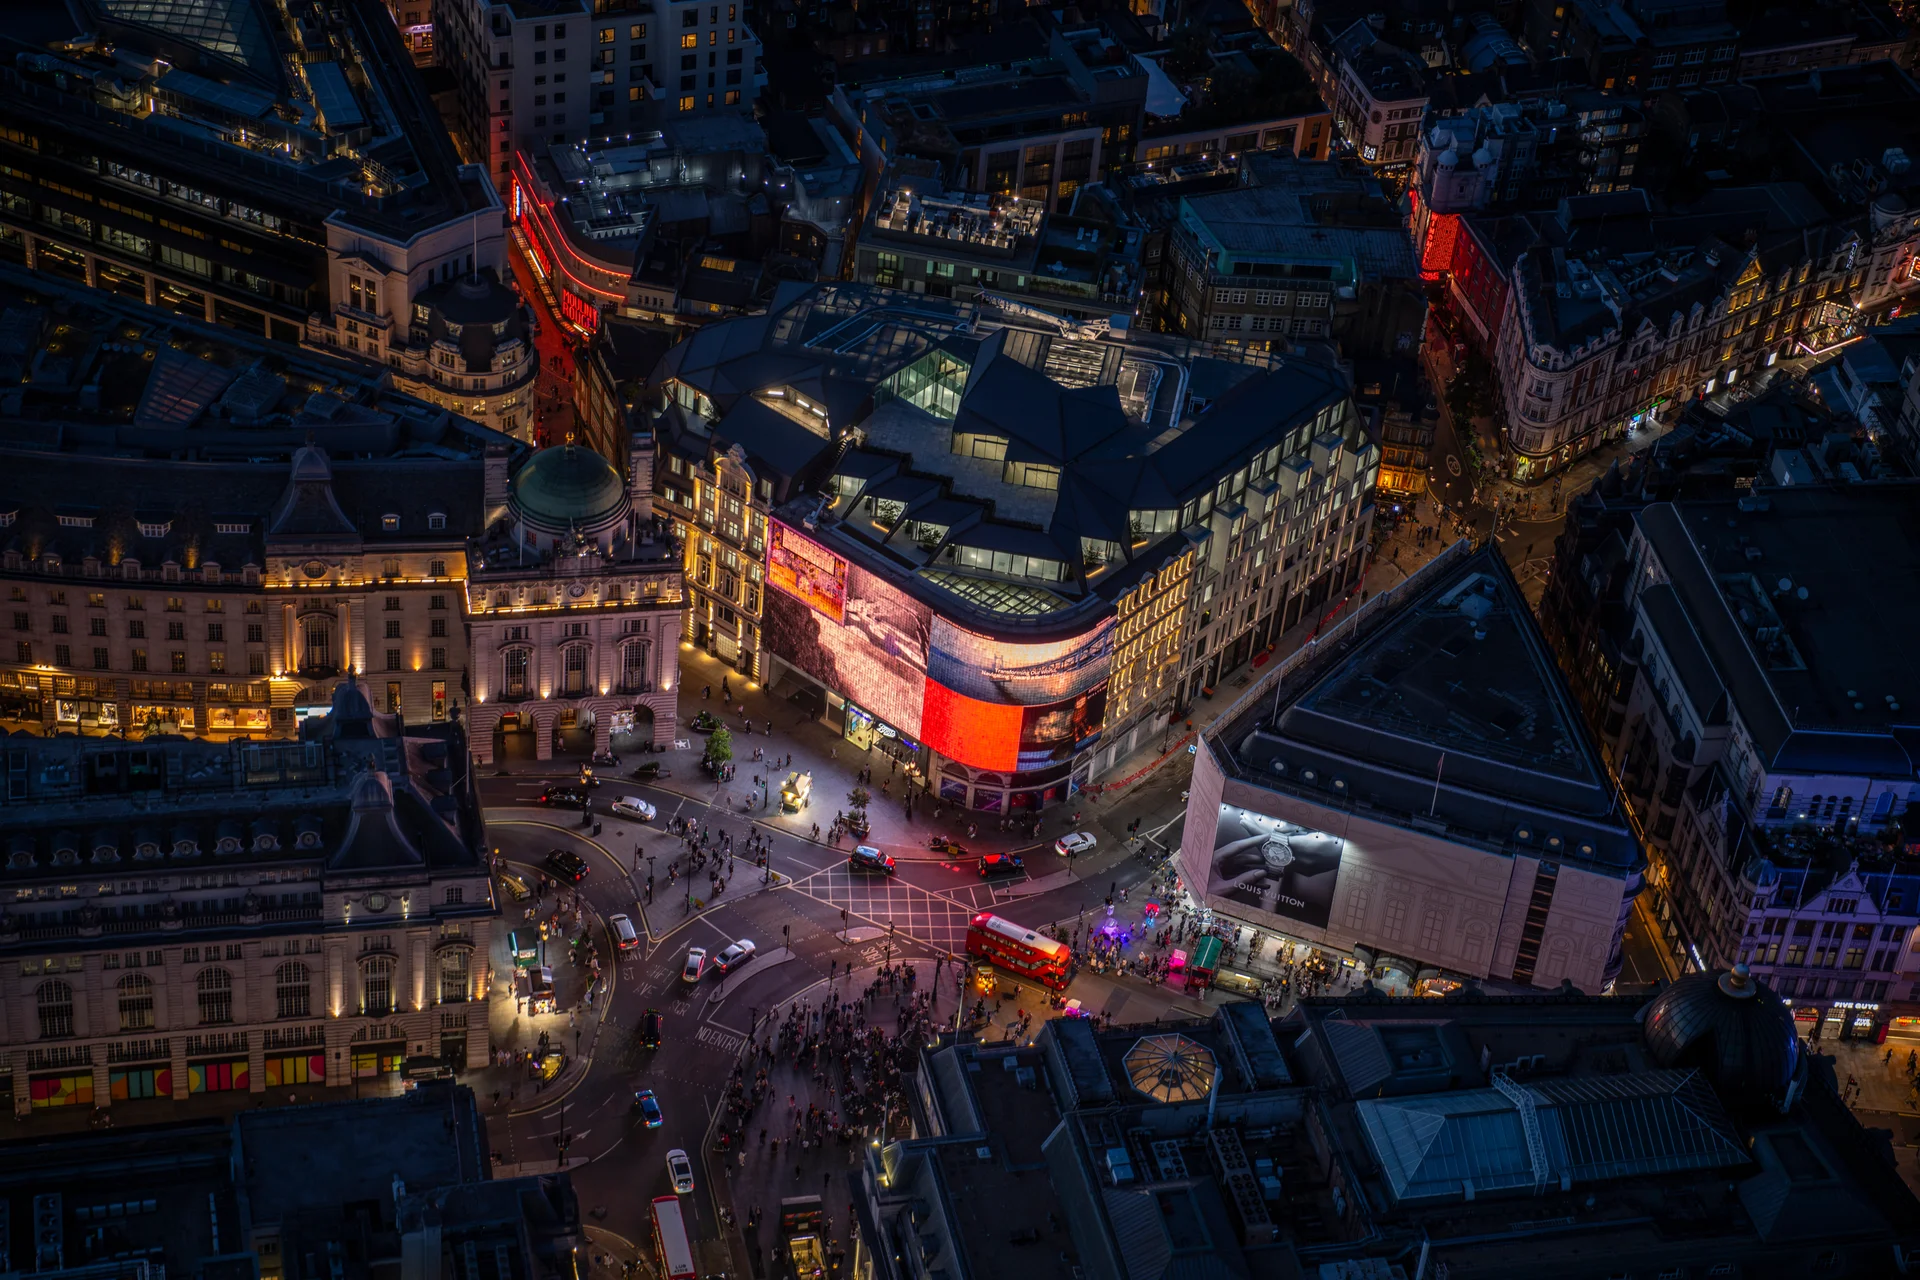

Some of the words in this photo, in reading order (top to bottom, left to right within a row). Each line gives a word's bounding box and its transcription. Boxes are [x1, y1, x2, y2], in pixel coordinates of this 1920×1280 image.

[562, 288, 593, 319] MOULIN
[994, 667, 1030, 676] Transforming
[1233, 881, 1261, 895] LOUIS
[1264, 889, 1305, 908] VUITTON
[861, 946, 883, 962] BUS
[1834, 1001, 1853, 1009] FIVE
[695, 1026, 709, 1042] NO
[708, 1031, 744, 1051] ENTRY
